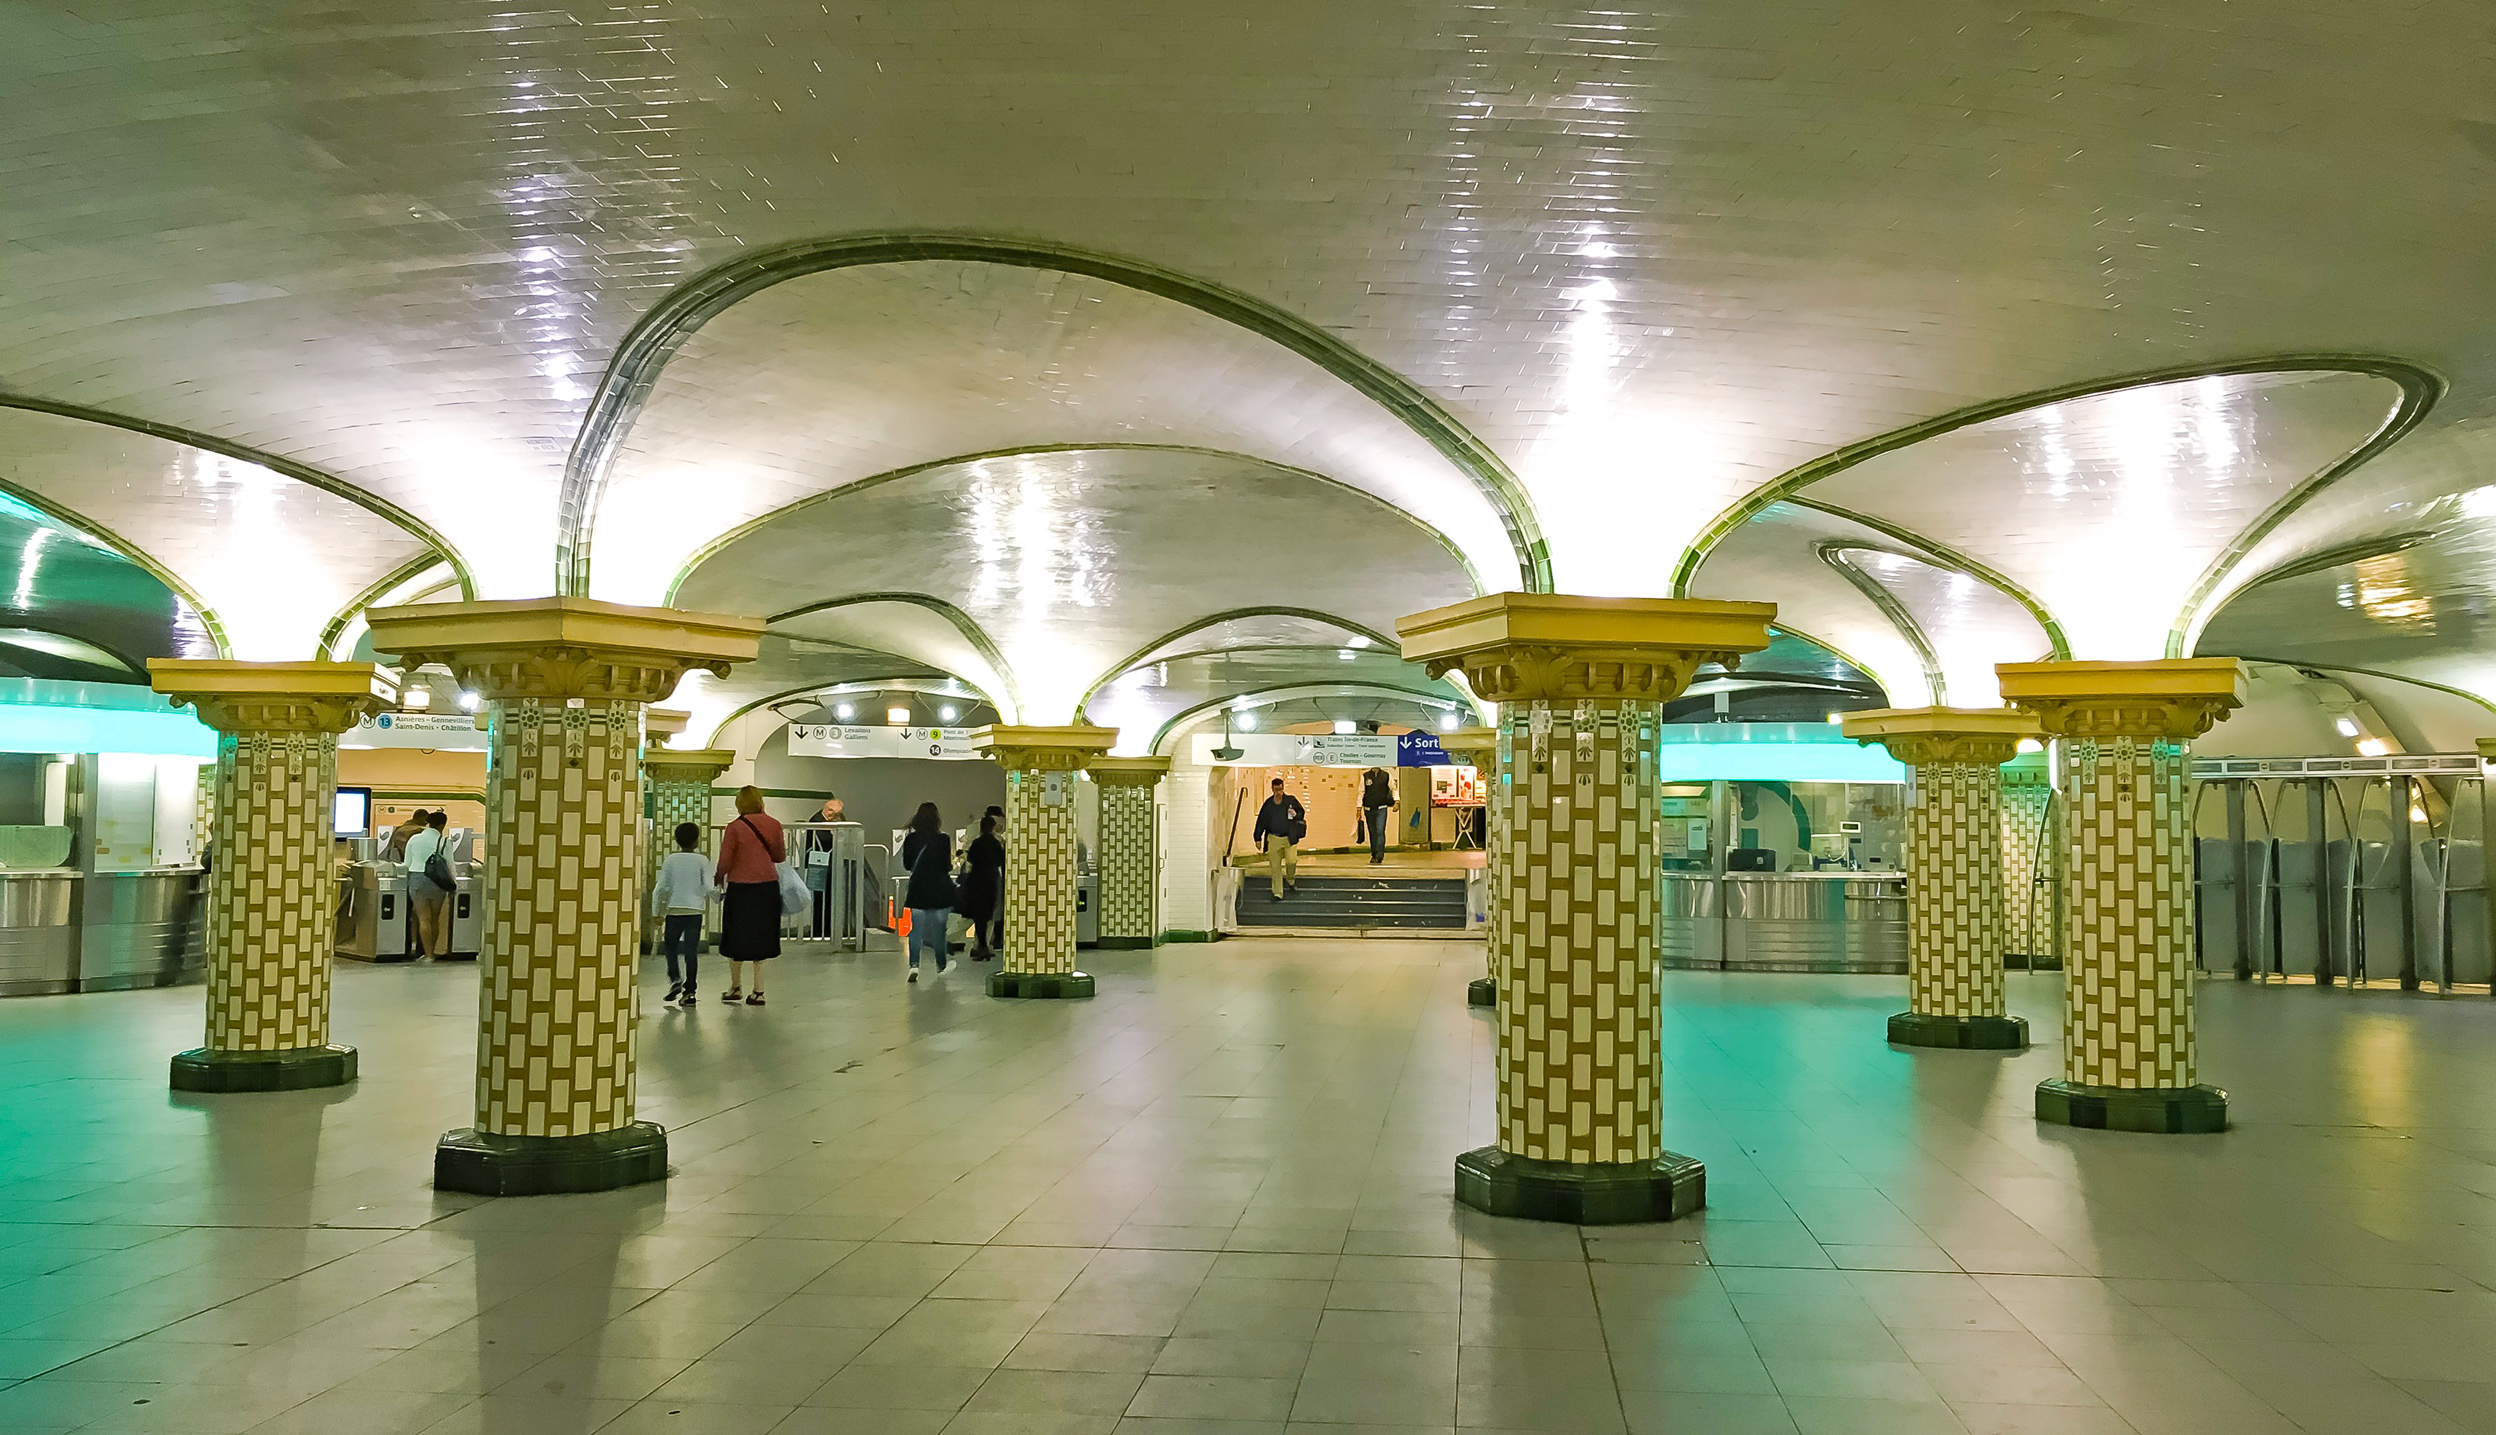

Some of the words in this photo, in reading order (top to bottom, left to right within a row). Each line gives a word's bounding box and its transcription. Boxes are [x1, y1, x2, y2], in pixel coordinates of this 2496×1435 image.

[380, 717, 391, 726] 13
[431, 717, 475, 725] Gennevilliers
[395, 723, 435, 731] Saint-Denis
[441, 724, 472, 732] Châtillon
[816, 729, 824, 737] M
[933, 731, 939, 739] 9
[931, 746, 940, 754] 14
